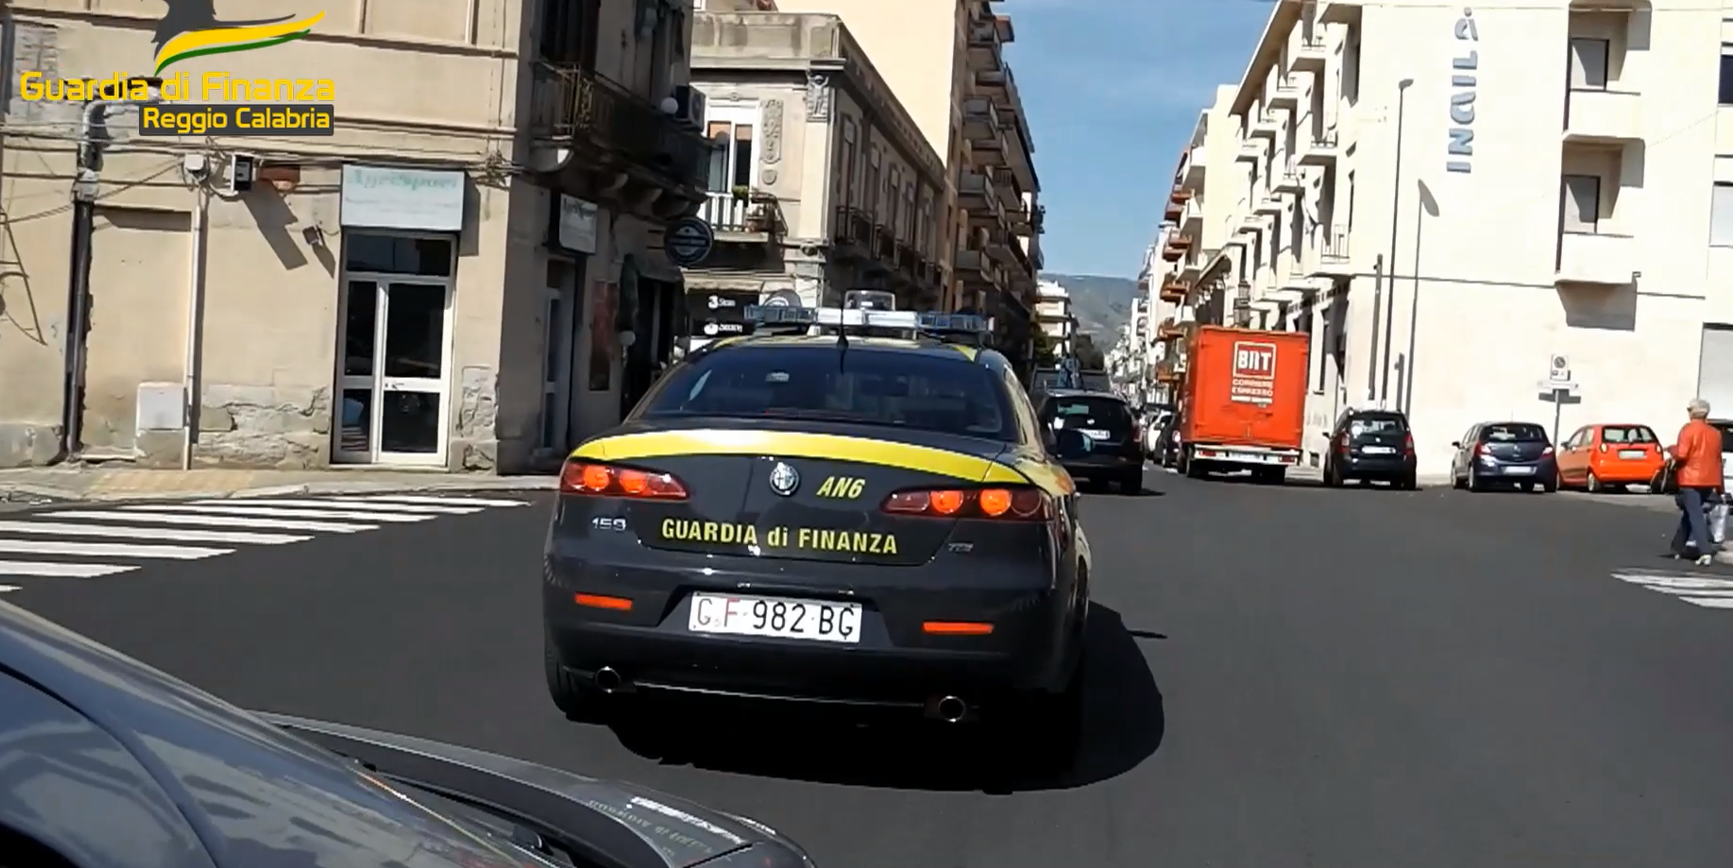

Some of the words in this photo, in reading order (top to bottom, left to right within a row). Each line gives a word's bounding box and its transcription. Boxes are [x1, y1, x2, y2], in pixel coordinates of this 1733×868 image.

[1238, 350, 1272, 371] BRT
[816, 476, 866, 499] AN6
[592, 517, 627, 531] 159
[662, 518, 758, 545] GUARDIA
[767, 527, 788, 547] di
[798, 528, 897, 554] FINANZA
